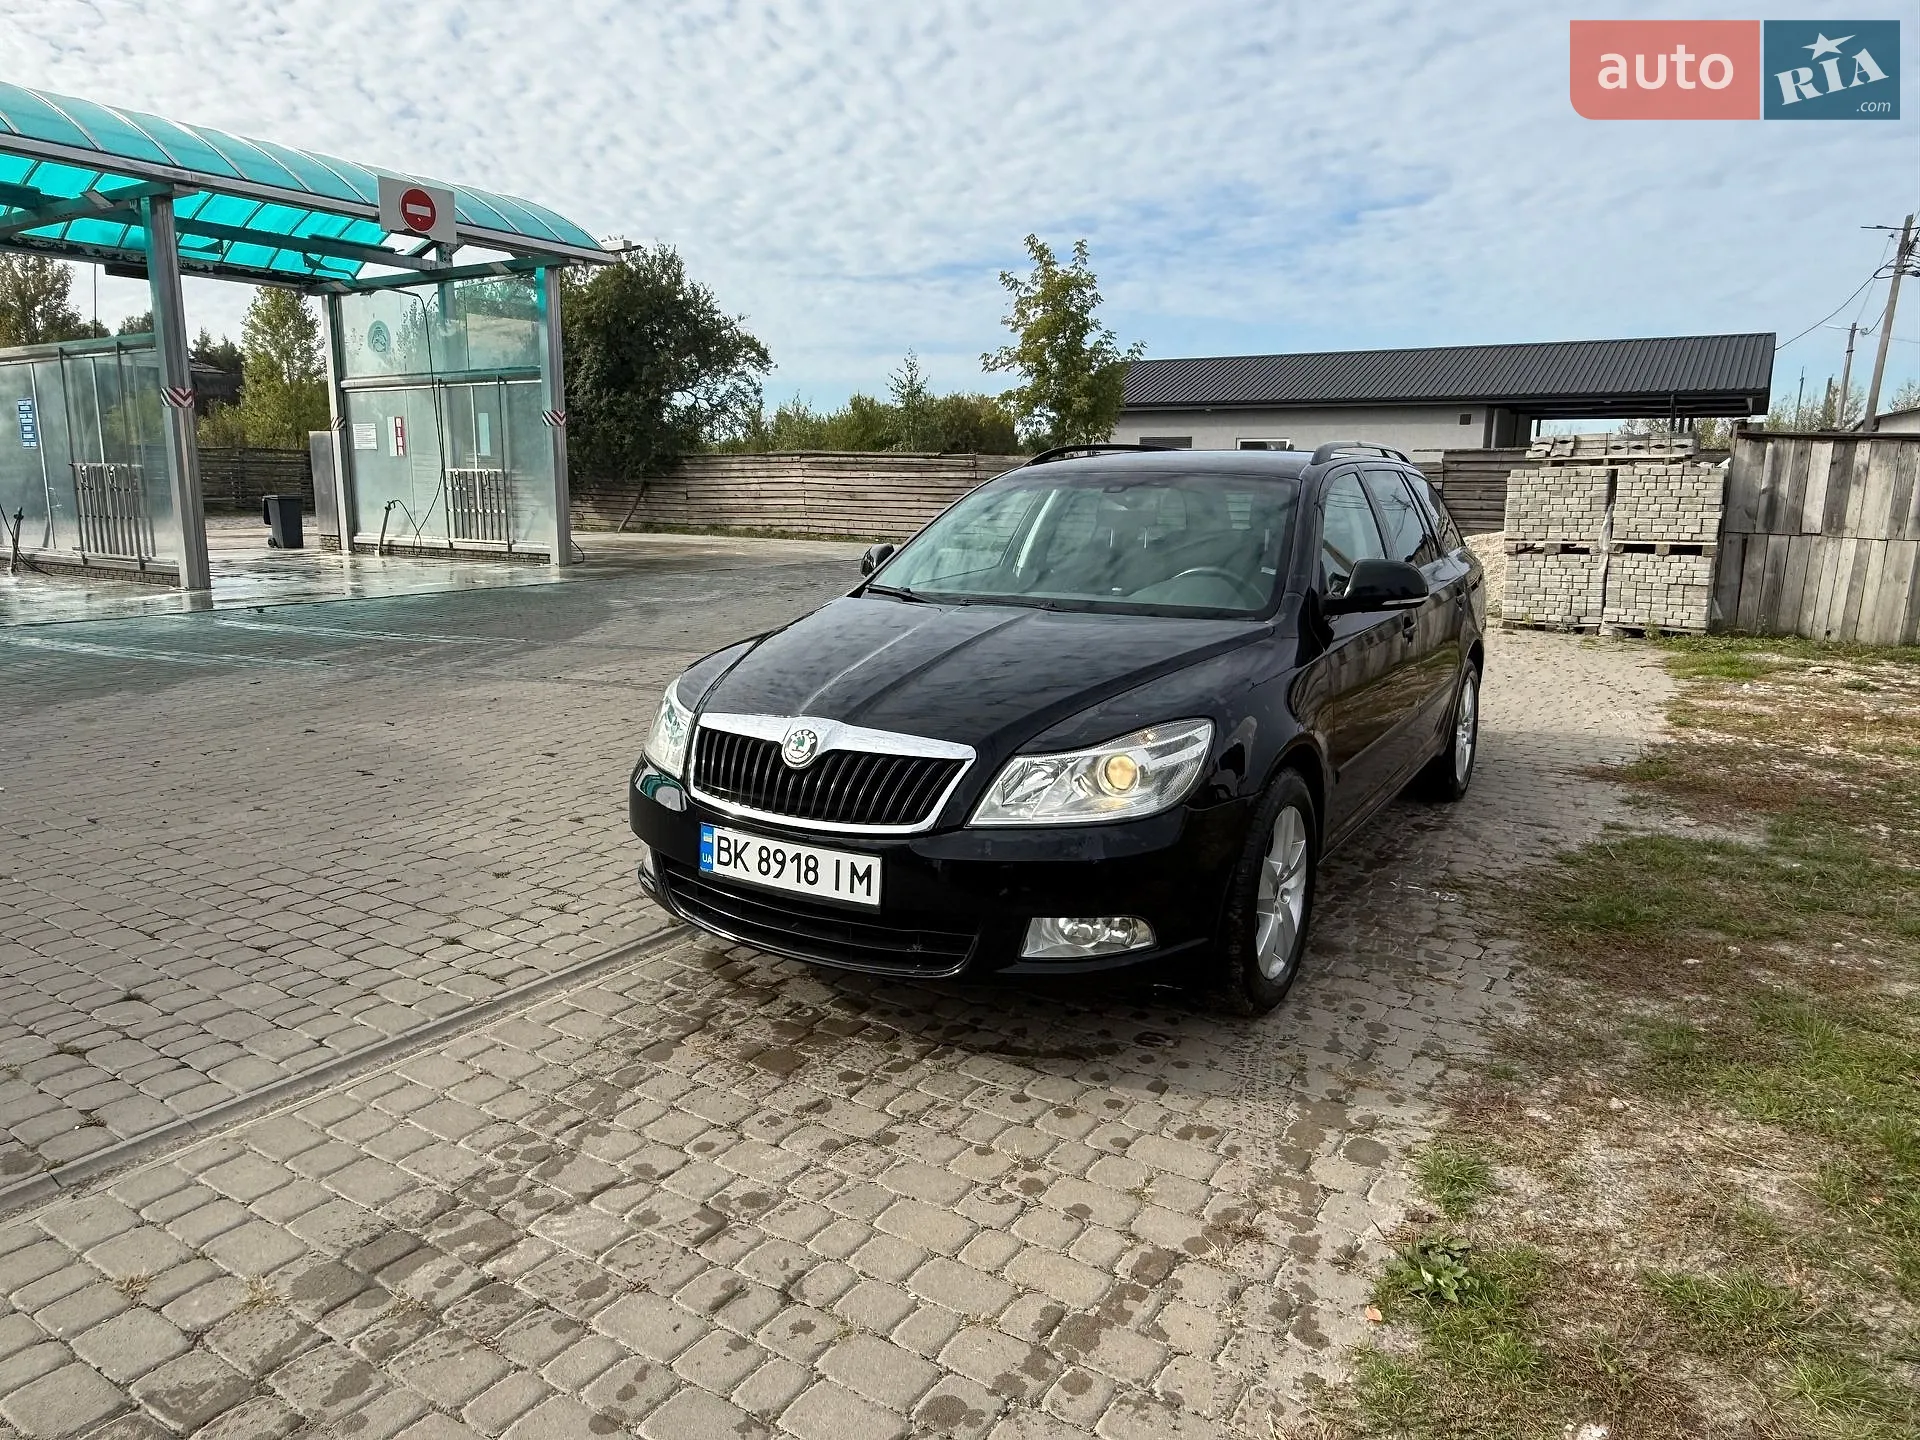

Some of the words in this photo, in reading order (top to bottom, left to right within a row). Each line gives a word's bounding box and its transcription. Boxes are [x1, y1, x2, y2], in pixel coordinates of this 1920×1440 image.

[702, 852, 713, 864] UA
[717, 835, 750, 872] BK
[757, 845, 819, 886] 8918
[834, 859, 873, 897] IM
